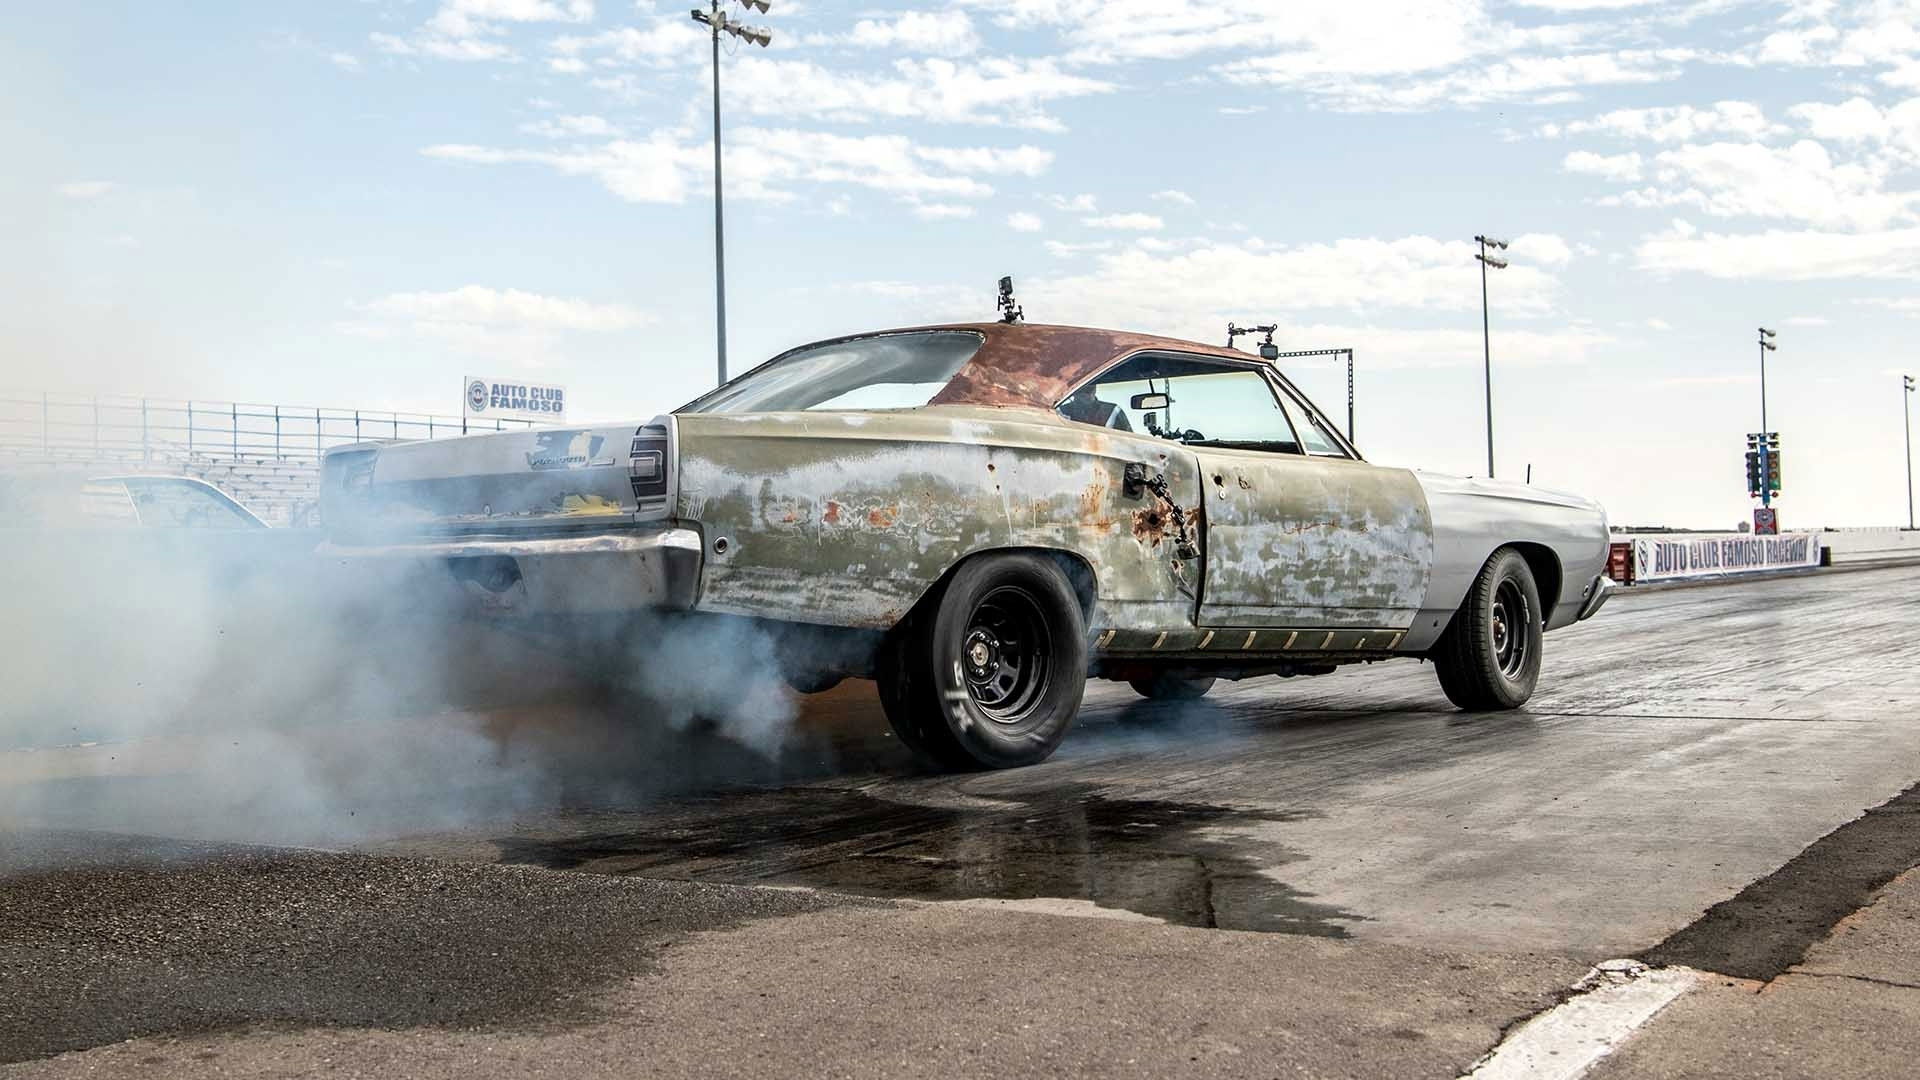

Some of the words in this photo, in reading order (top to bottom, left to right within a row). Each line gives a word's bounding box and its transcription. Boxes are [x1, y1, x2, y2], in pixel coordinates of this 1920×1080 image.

[491, 384, 527, 398] AUTO
[530, 387, 563, 401] CLUB
[490, 397, 563, 412] FAMOSO
[1655, 542, 1687, 573] AUTO
[1690, 540, 1719, 570] CLUB
[1721, 537, 1765, 567] FAMOSO
[1766, 534, 1808, 563] RACEWAY
